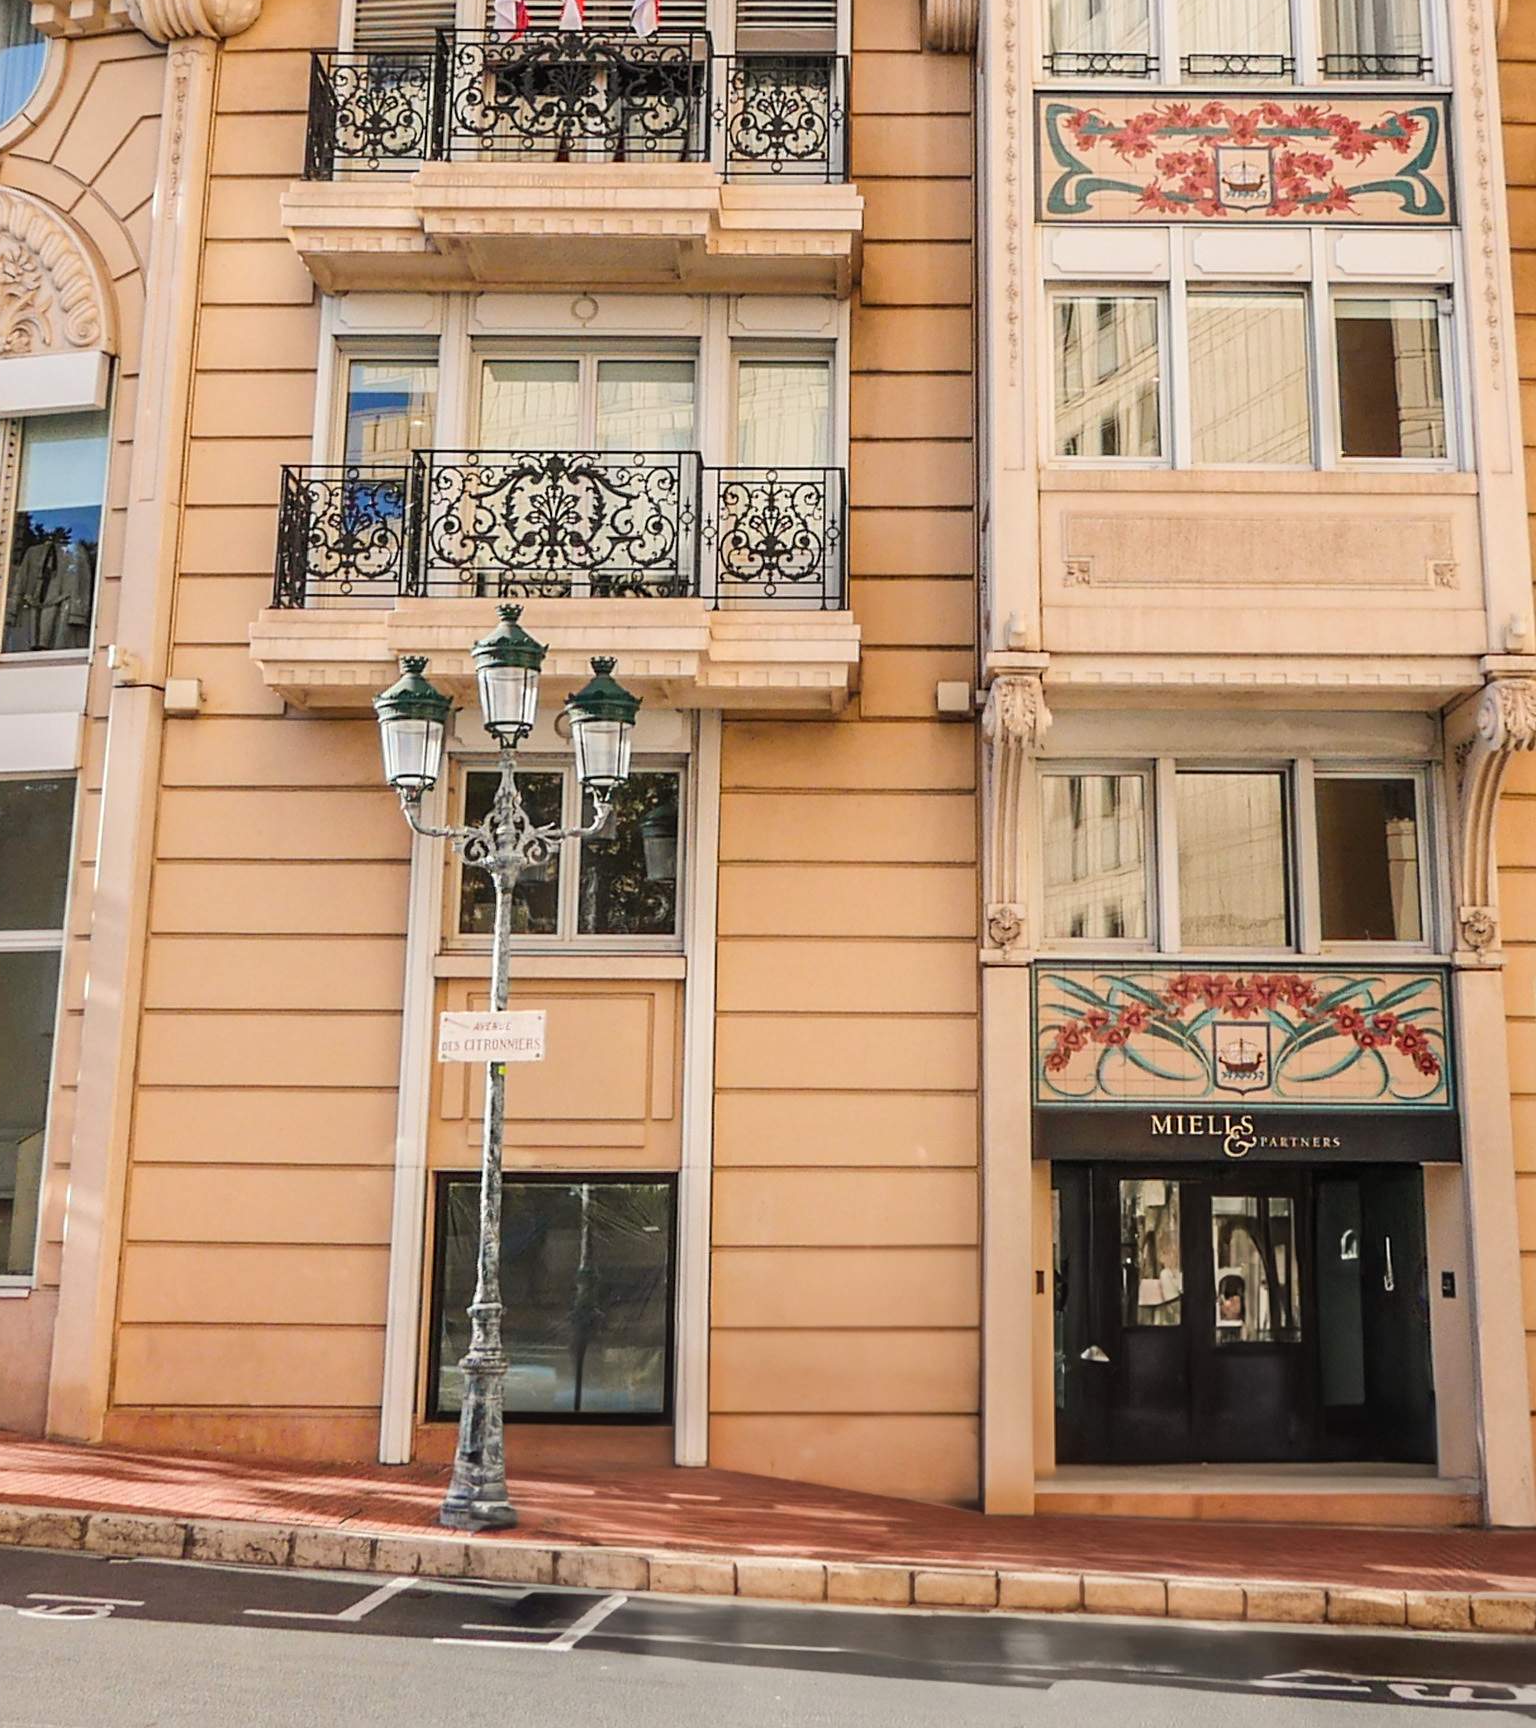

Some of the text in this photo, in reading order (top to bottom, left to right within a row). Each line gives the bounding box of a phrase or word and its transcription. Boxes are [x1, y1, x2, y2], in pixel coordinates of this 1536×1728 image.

[473, 1021, 513, 1031] AVENUE
[441, 1038, 542, 1052] DES CITRONNIERS
[1223, 1125, 1257, 1158] &
[1260, 1135, 1341, 1148] PARTNERS
